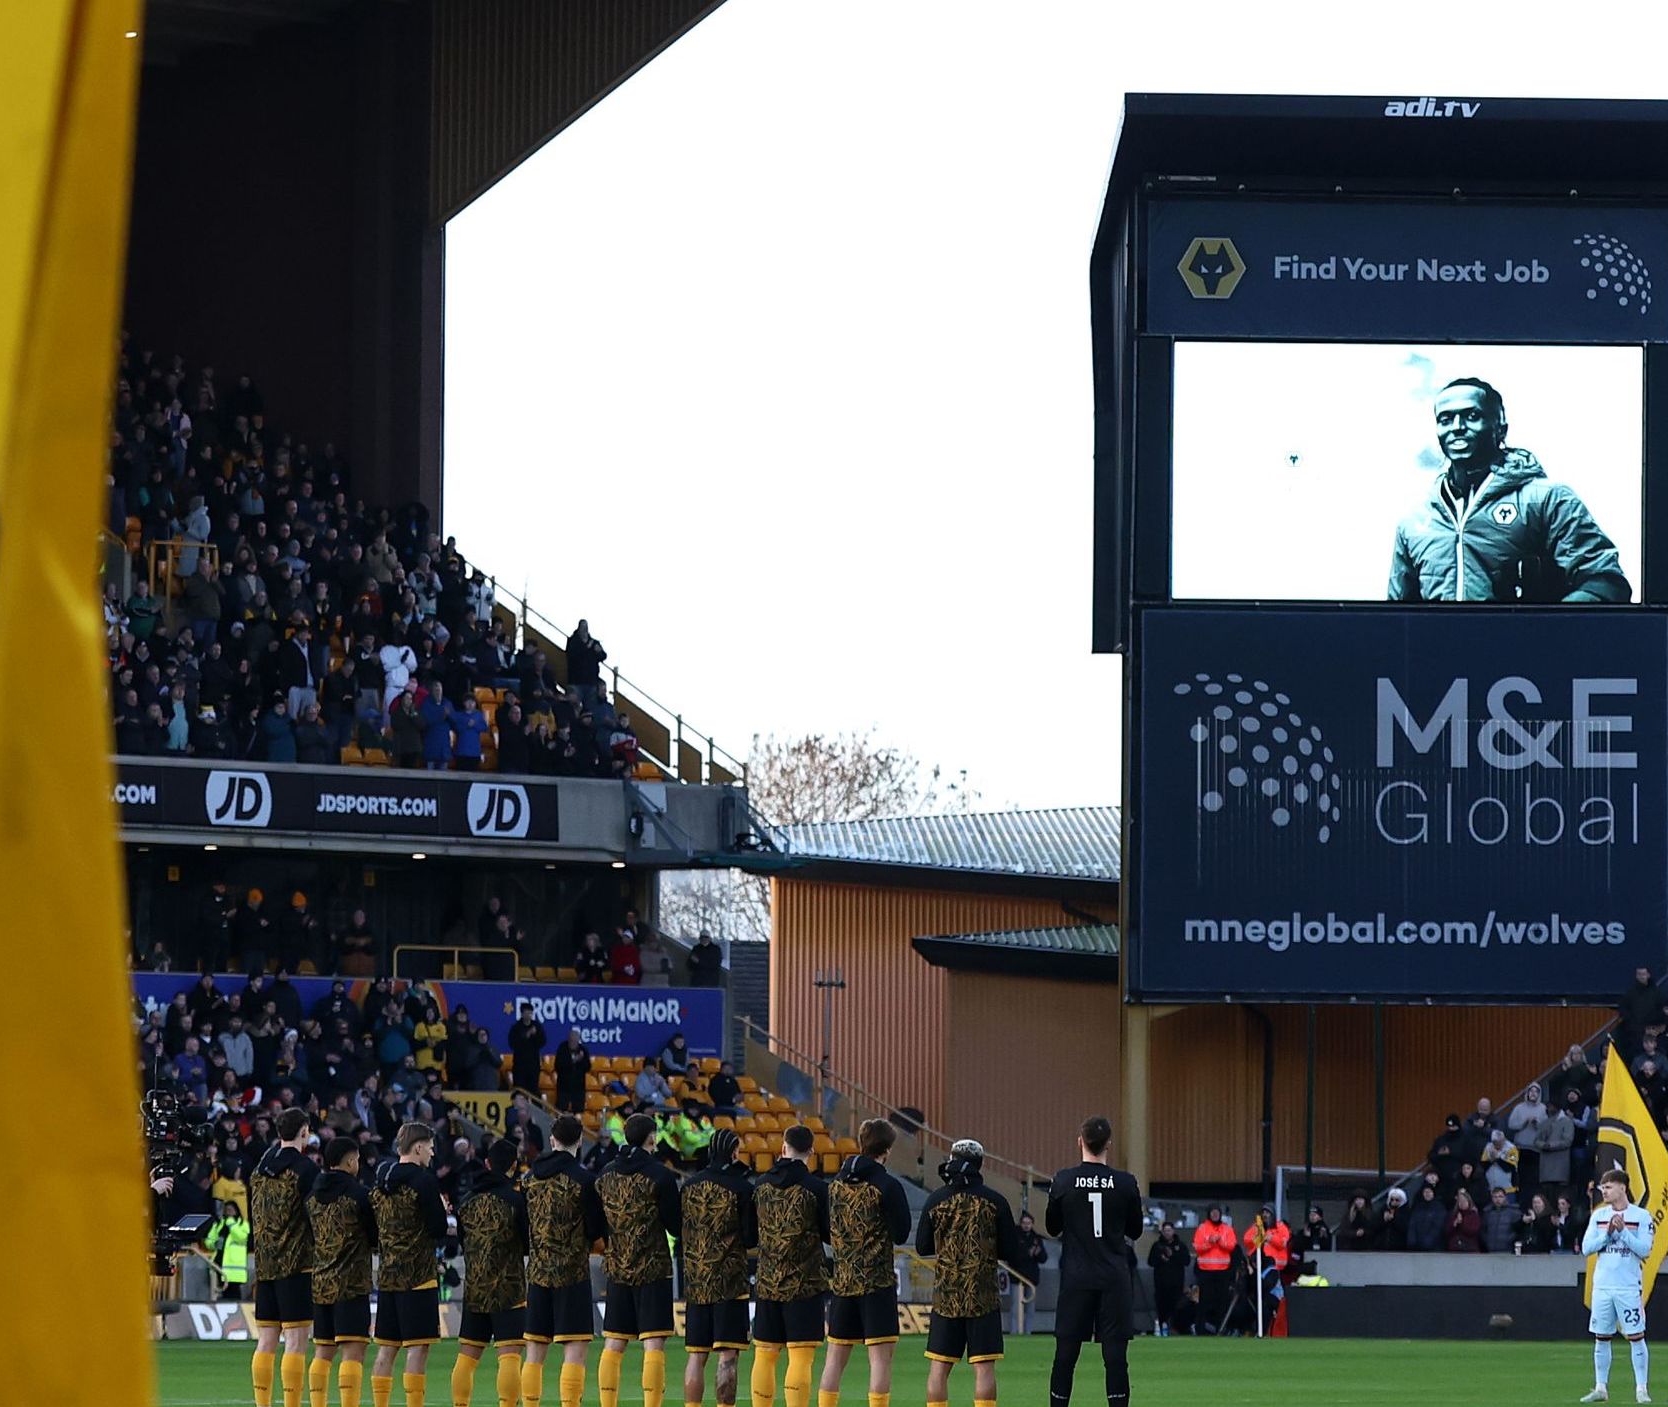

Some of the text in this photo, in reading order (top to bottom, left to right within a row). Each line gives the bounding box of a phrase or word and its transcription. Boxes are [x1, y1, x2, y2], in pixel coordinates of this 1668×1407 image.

[1384, 97, 1481, 118] adi.tv
[1274, 255, 1550, 283] Find Your Next Job
[1376, 676, 1638, 770] M&E
[215, 777, 264, 821] JD
[316, 793, 438, 817] JDSPORTS.COM
[475, 789, 522, 832] JD
[1375, 781, 1638, 845] Global
[1184, 911, 1626, 951] mneglobal.com/wolves
[1075, 1175, 1114, 1189] JOSÉ SÁ
[1088, 1192, 1102, 1238] 1
[1624, 1308, 1640, 1323] 23
